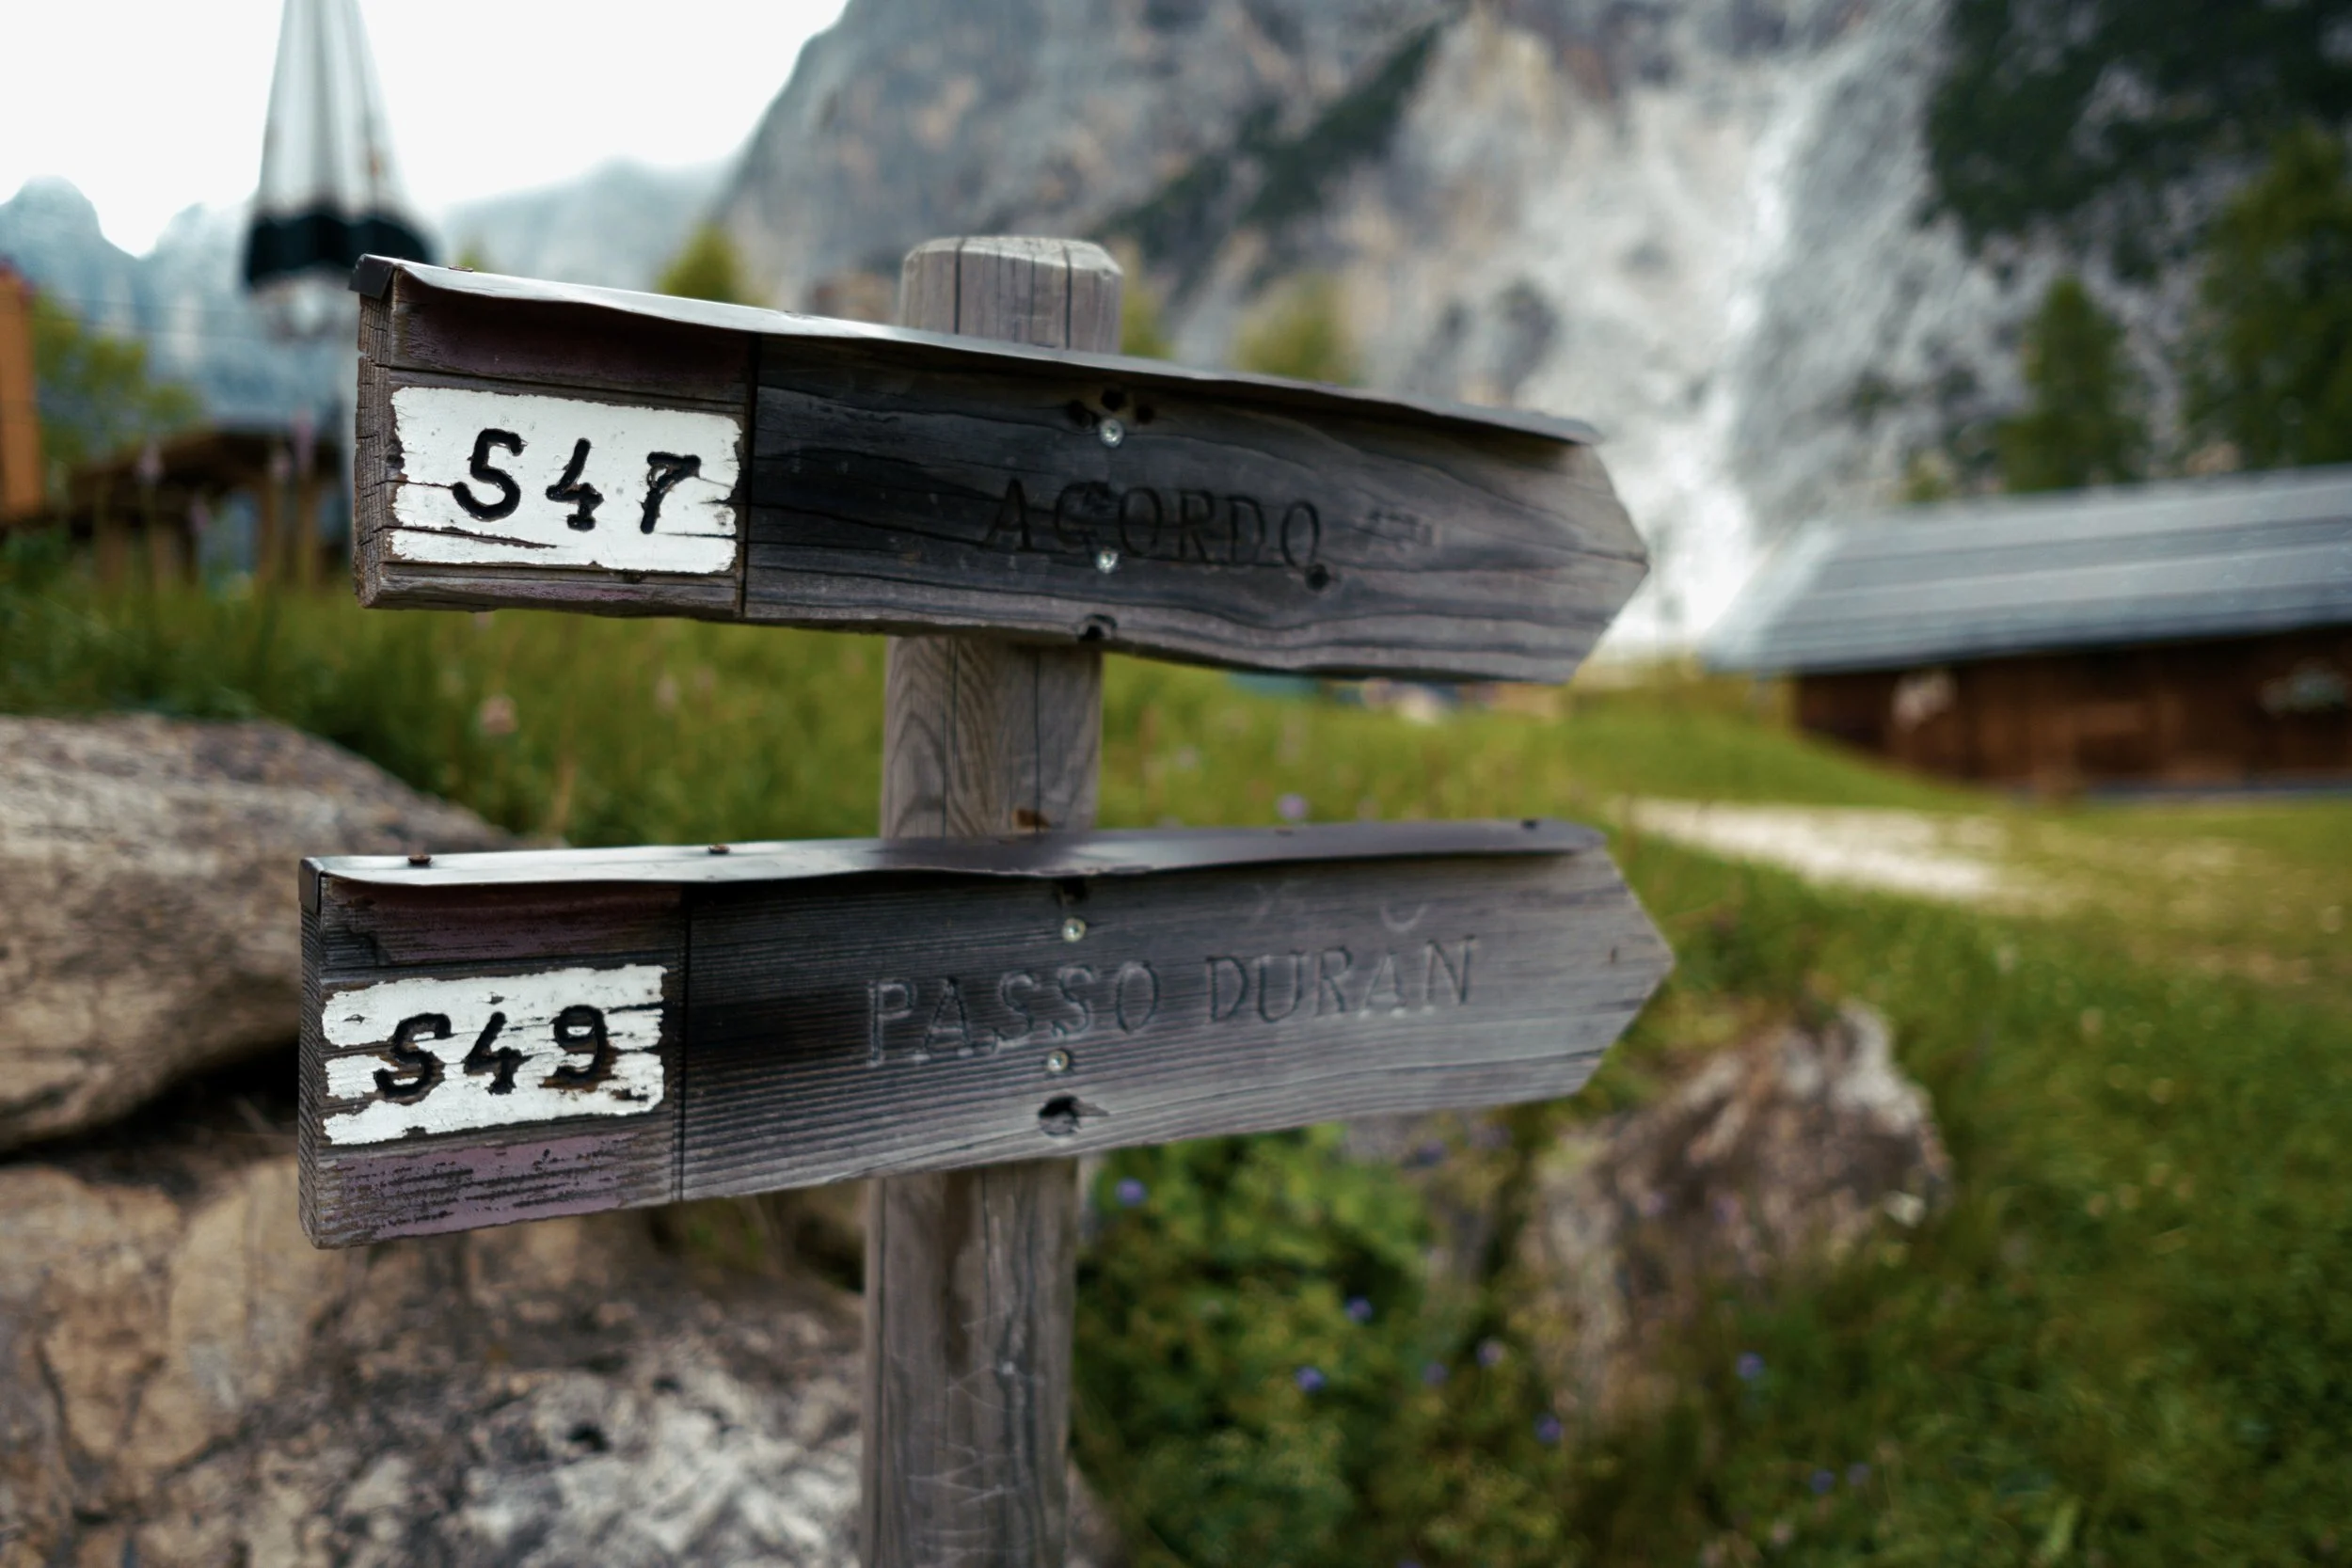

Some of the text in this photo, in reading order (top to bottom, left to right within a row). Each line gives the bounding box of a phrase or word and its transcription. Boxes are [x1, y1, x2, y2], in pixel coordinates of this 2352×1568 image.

[983, 476, 1322, 571] AGORDO
[866, 933, 1479, 1068] PASSO DURAN
